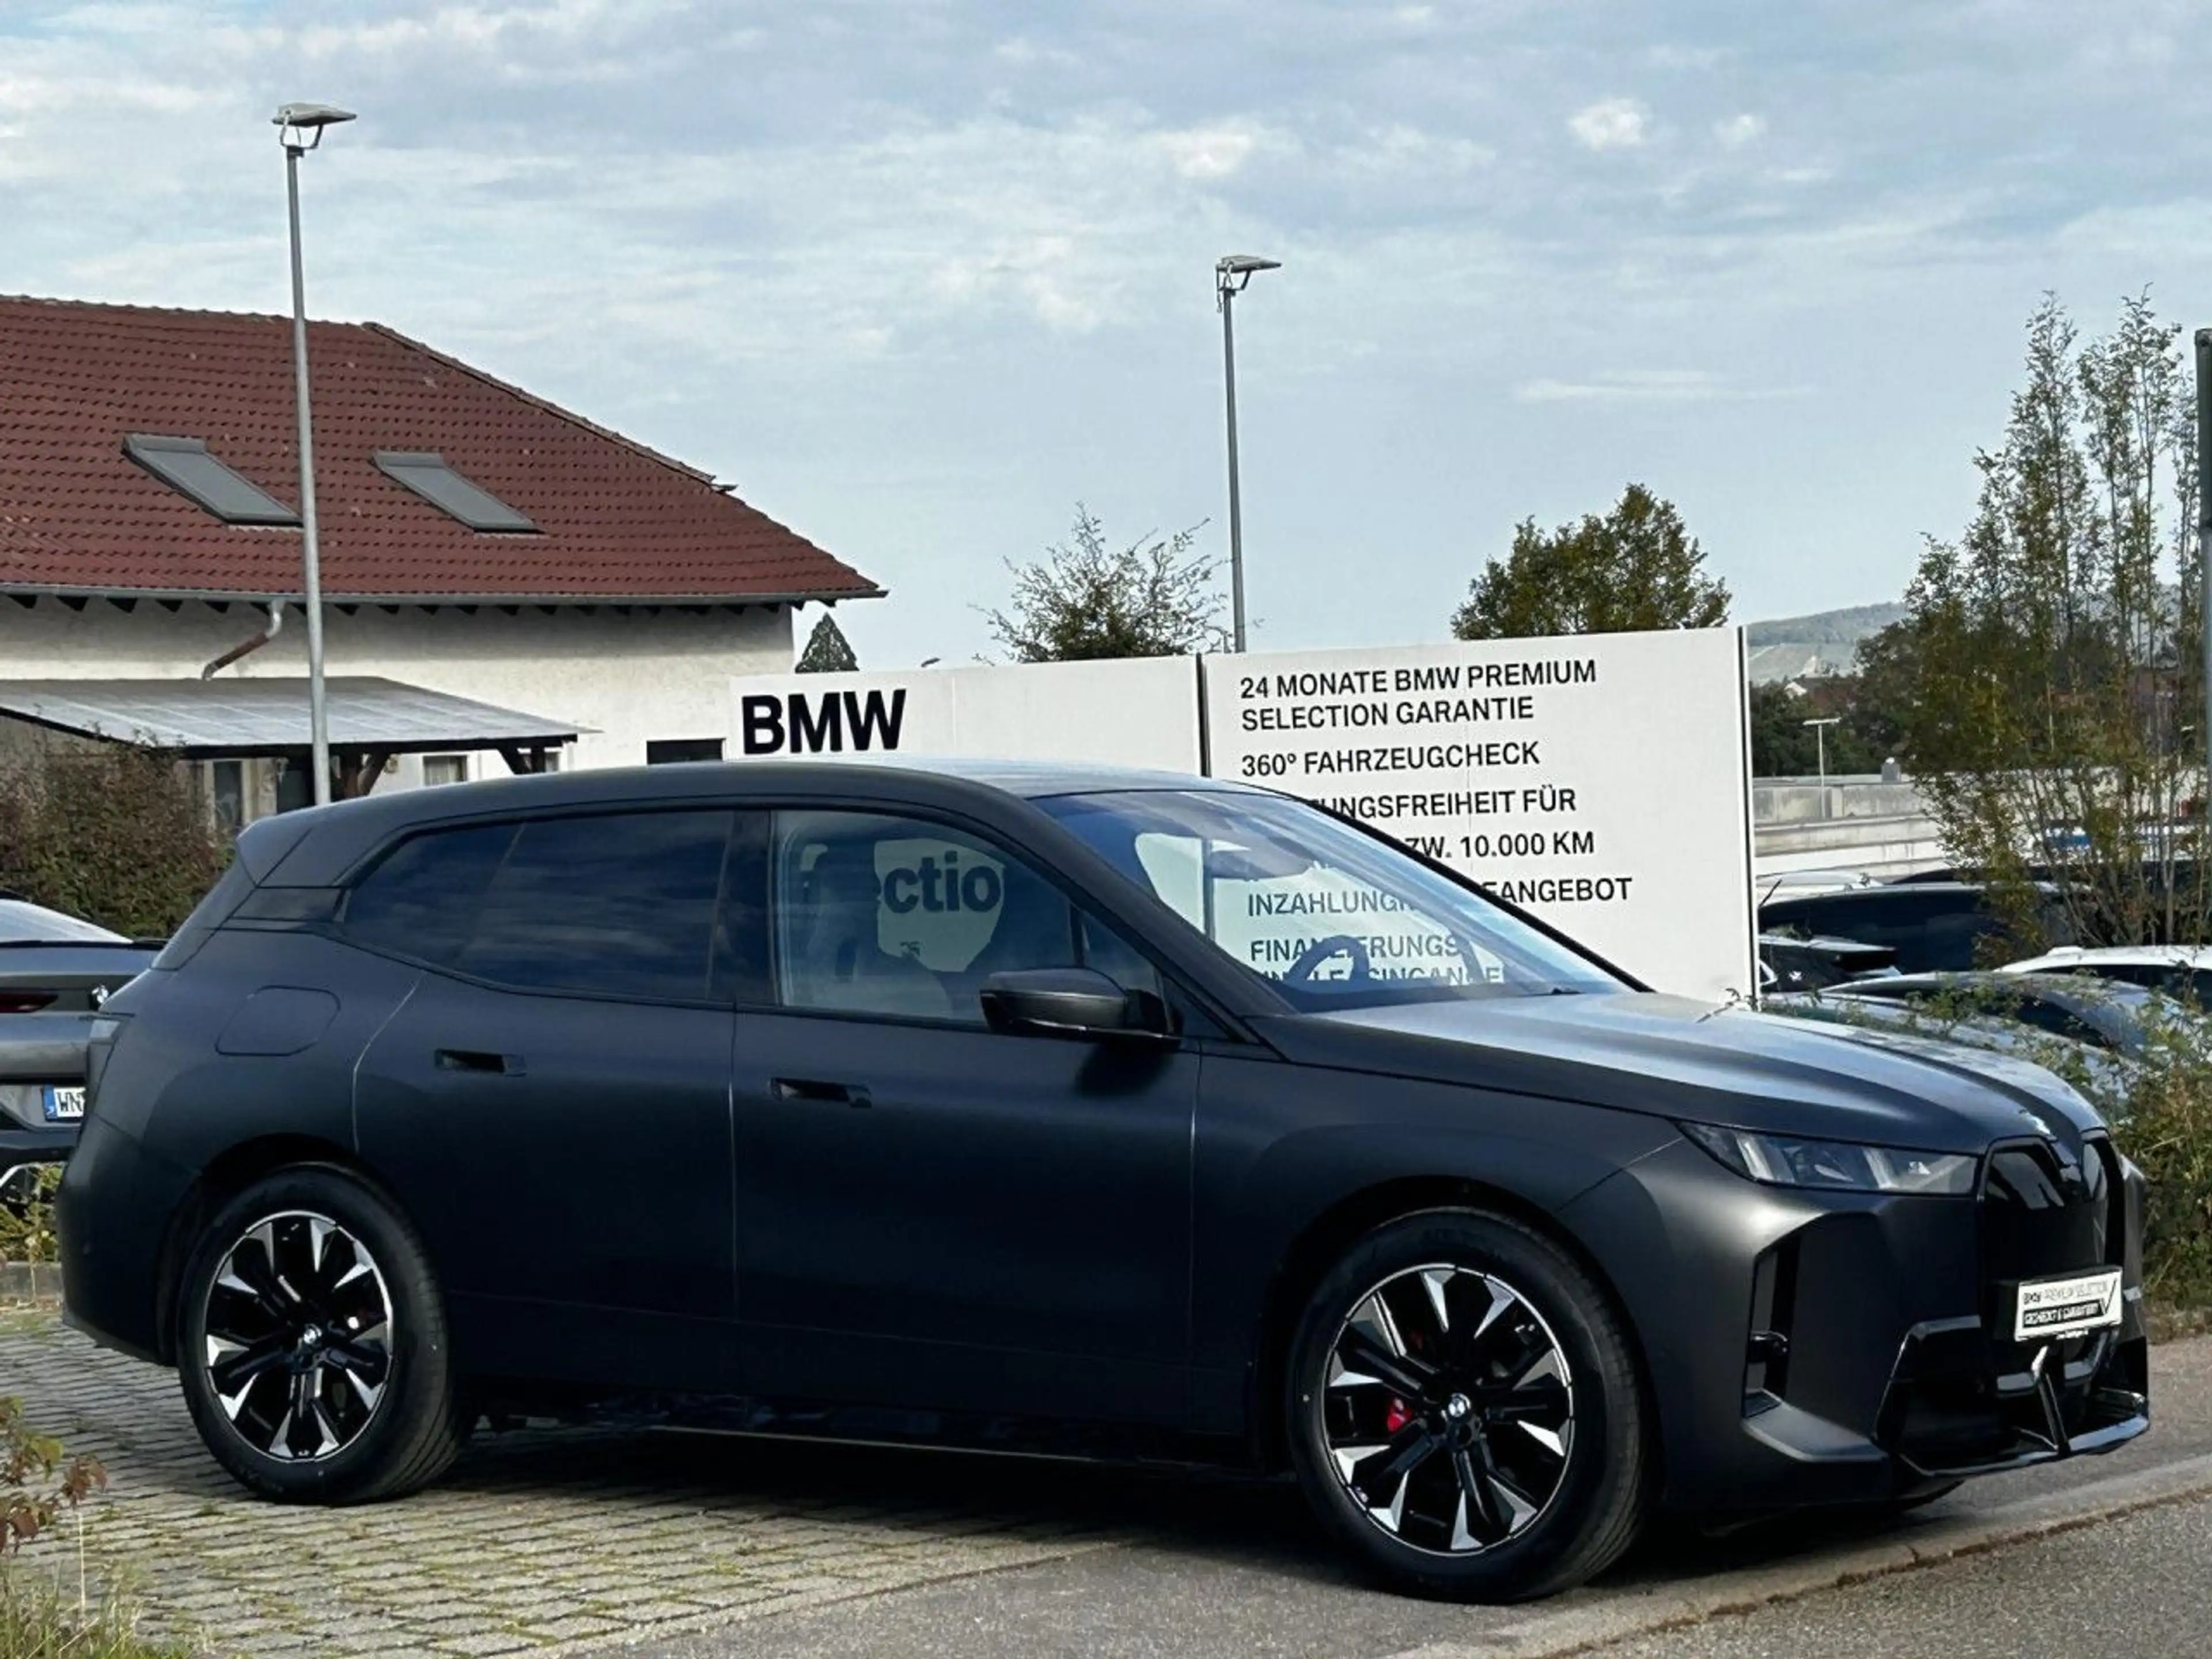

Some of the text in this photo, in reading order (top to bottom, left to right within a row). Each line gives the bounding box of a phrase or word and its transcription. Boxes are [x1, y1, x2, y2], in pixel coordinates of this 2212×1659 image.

[1240, 660, 1596, 699] 24 MONATE BMW PREMIUM
[741, 688, 907, 755] BMW
[1242, 696, 1534, 731] SELECTION GARANTIE
[1304, 741, 1540, 774] FAHRZEUGCHECK
[1522, 784, 1576, 813] FÜR
[1460, 832, 1545, 858] 10.000
[1553, 831, 1594, 854] KM
[1248, 891, 1404, 916] INZAHLUNG
